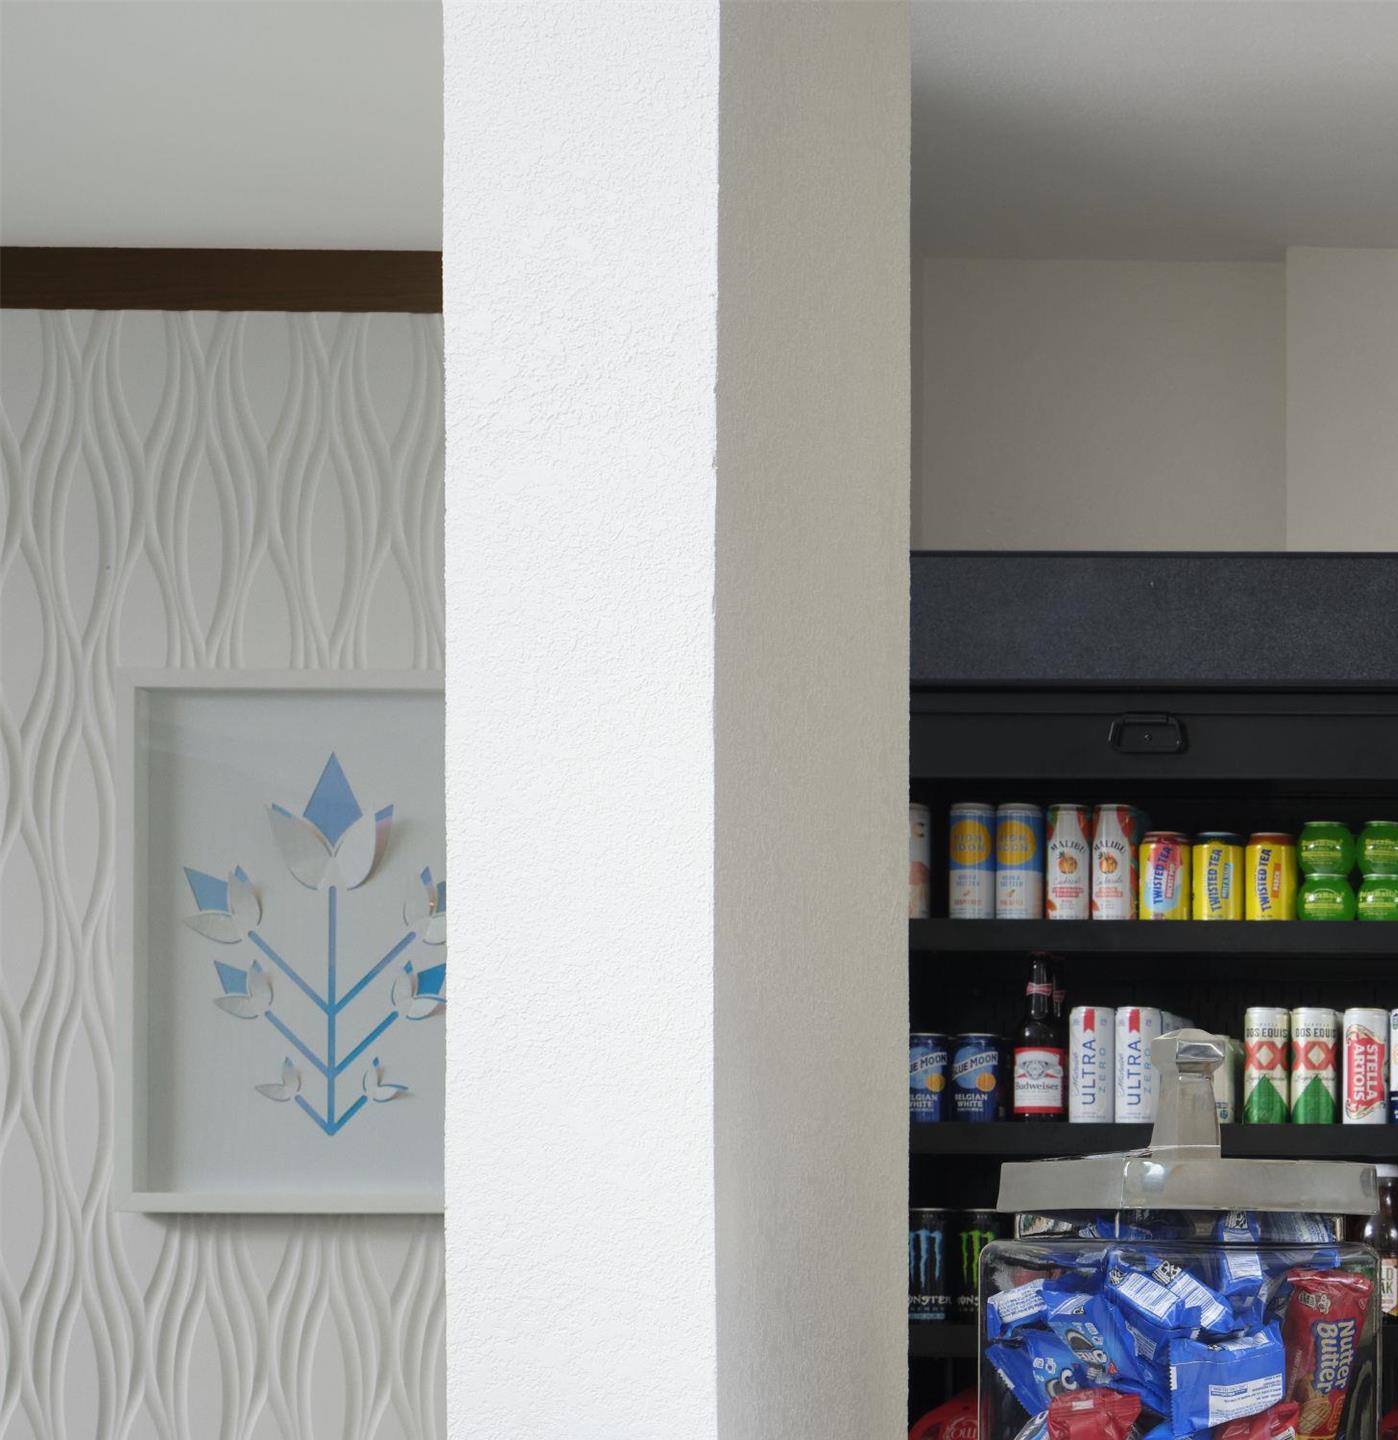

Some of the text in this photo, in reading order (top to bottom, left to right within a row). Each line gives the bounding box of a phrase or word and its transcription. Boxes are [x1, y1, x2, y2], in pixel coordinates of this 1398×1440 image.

[1152, 863, 1166, 905] TWISTED
[1206, 868, 1223, 913] TWISTED
[1256, 868, 1272, 913] TWISTED
[970, 1052, 998, 1070] MOON
[1014, 1081, 1060, 1092] Budweiser
[1081, 1038, 1097, 1106] ULTRA
[1126, 1038, 1142, 1106] ULTRA
[1353, 1042, 1366, 1102] ARTOIS
[1364, 1044, 1378, 1101] STELLA
[956, 1100, 984, 1109] WHITE
[1316, 1321, 1339, 1394] Butter
[1334, 1320, 1356, 1392] Nutter
